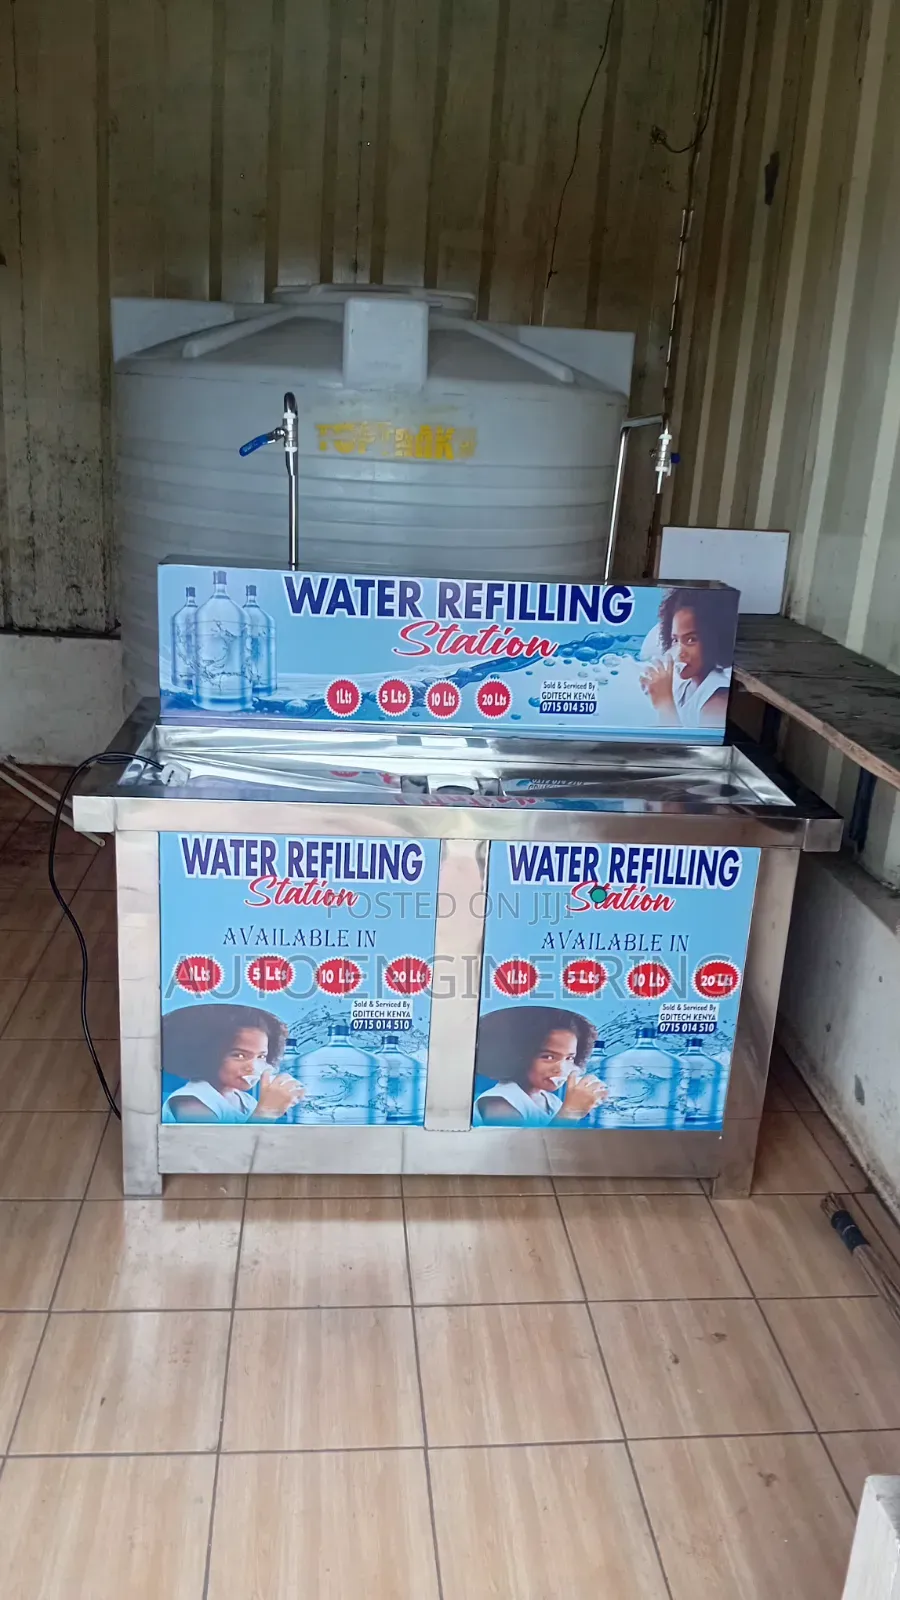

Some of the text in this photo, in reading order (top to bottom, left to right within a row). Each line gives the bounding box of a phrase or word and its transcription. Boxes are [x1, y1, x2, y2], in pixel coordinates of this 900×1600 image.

[284, 576, 634, 624] WATER REFILLING
[393, 620, 558, 657] Station
[543, 681, 555, 689] Sold
[563, 682, 587, 690] Serviced
[589, 682, 595, 691] By
[382, 689, 406, 704] 5 Lts
[431, 691, 456, 707] 10 Lts
[482, 692, 506, 706] 20 Lts
[542, 702, 594, 712] 0715 014 510
[181, 837, 423, 882] WATER REFILLING
[509, 845, 740, 887] WATER REFILLING
[244, 874, 358, 907] Station
[223, 925, 376, 948] AVAILABLE IN
[541, 930, 689, 952] AVAILABLE IN
[253, 970, 261, 981] 5
[321, 970, 334, 983] 10
[567, 972, 574, 983] 5
[649, 971, 665, 987] Lts
[701, 974, 713, 986] 20
[403, 1001, 410, 1009] By
[353, 1020, 409, 1029] 0715 014 510
[660, 1023, 714, 1032] 0715 014 510
